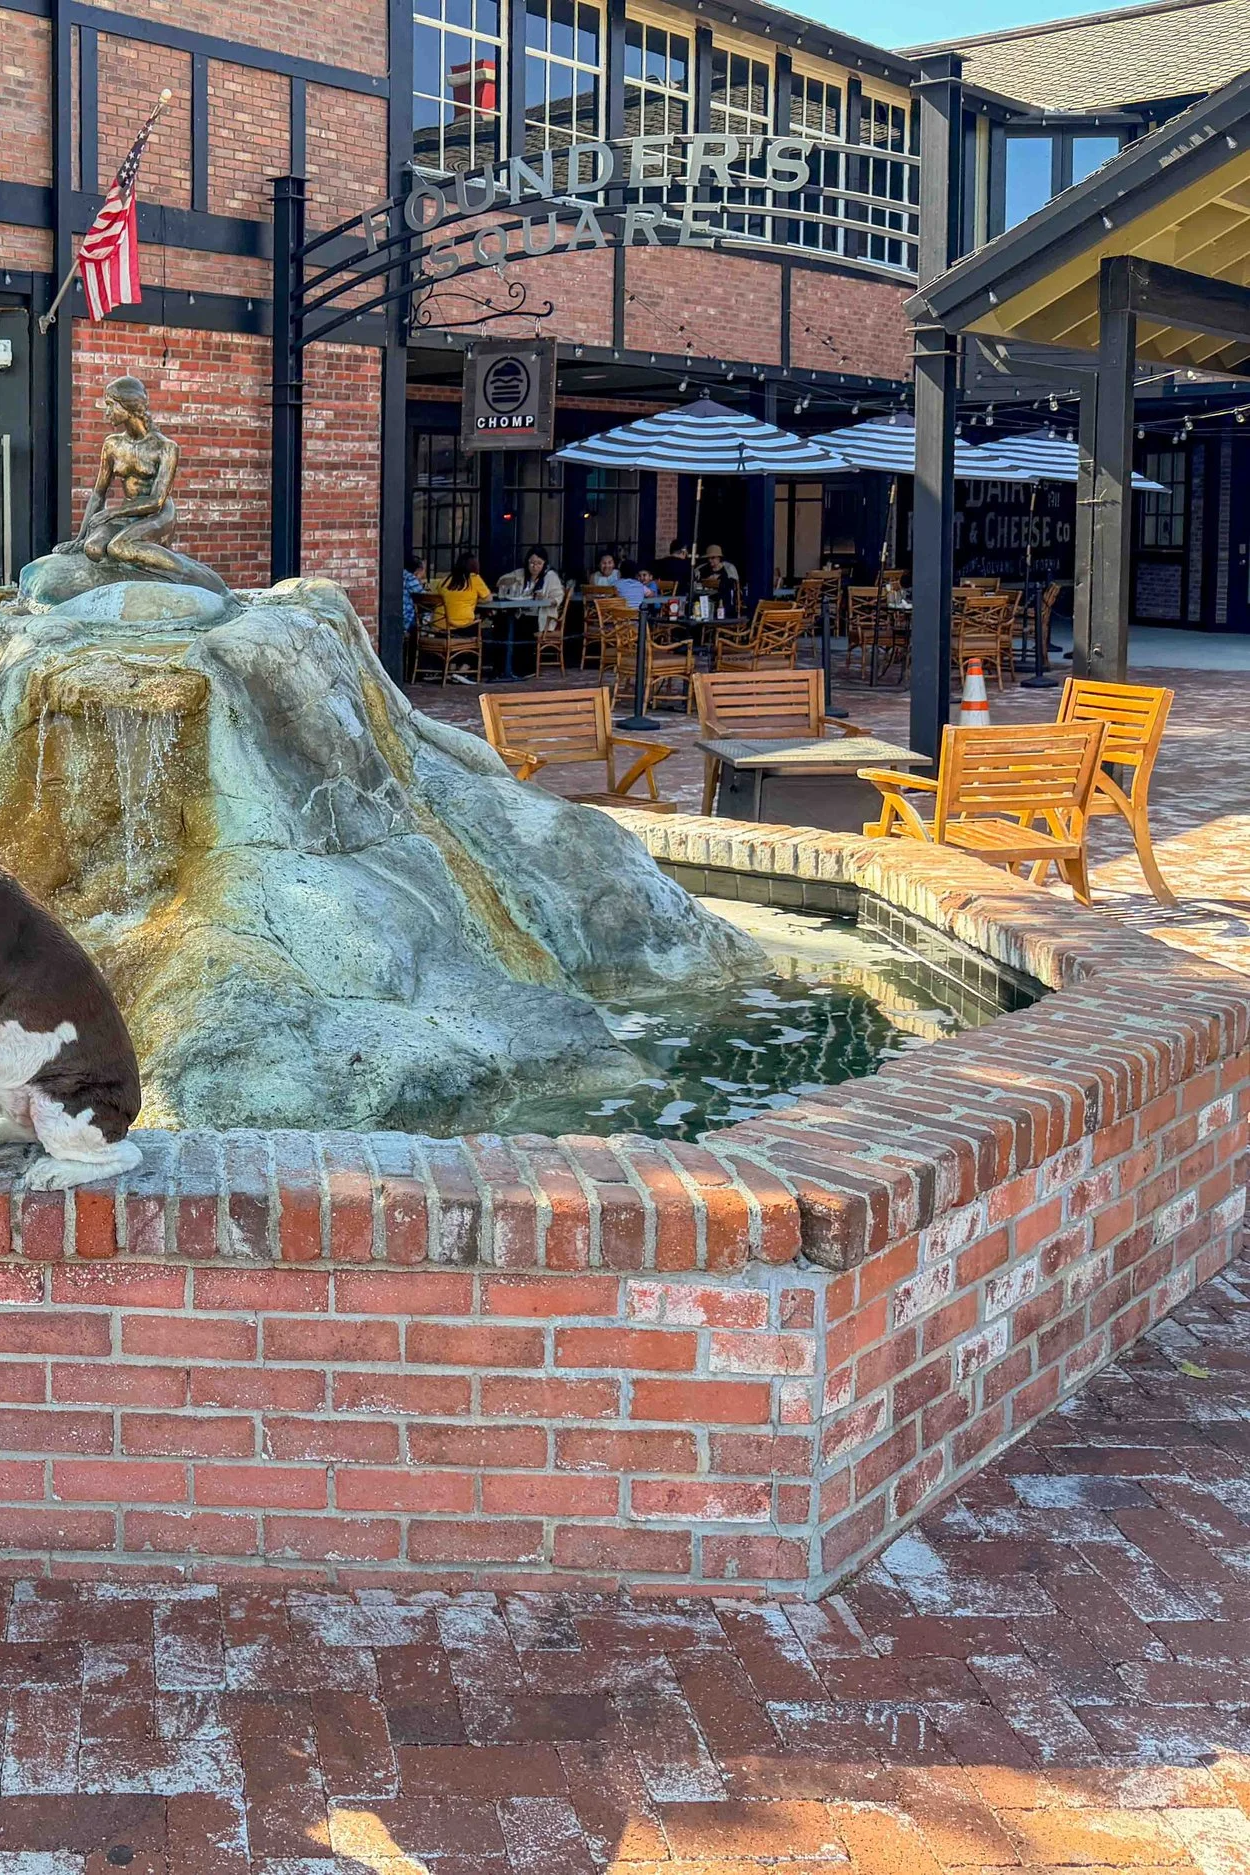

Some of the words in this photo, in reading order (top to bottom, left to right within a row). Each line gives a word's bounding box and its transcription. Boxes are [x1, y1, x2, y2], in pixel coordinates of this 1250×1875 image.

[361, 133, 812, 255] FOUNDER'S
[429, 201, 722, 279] SQUARE
[477, 415, 534, 429] CHOMP
[965, 479, 1037, 508] DAIR
[984, 511, 1052, 549] CHEESE
